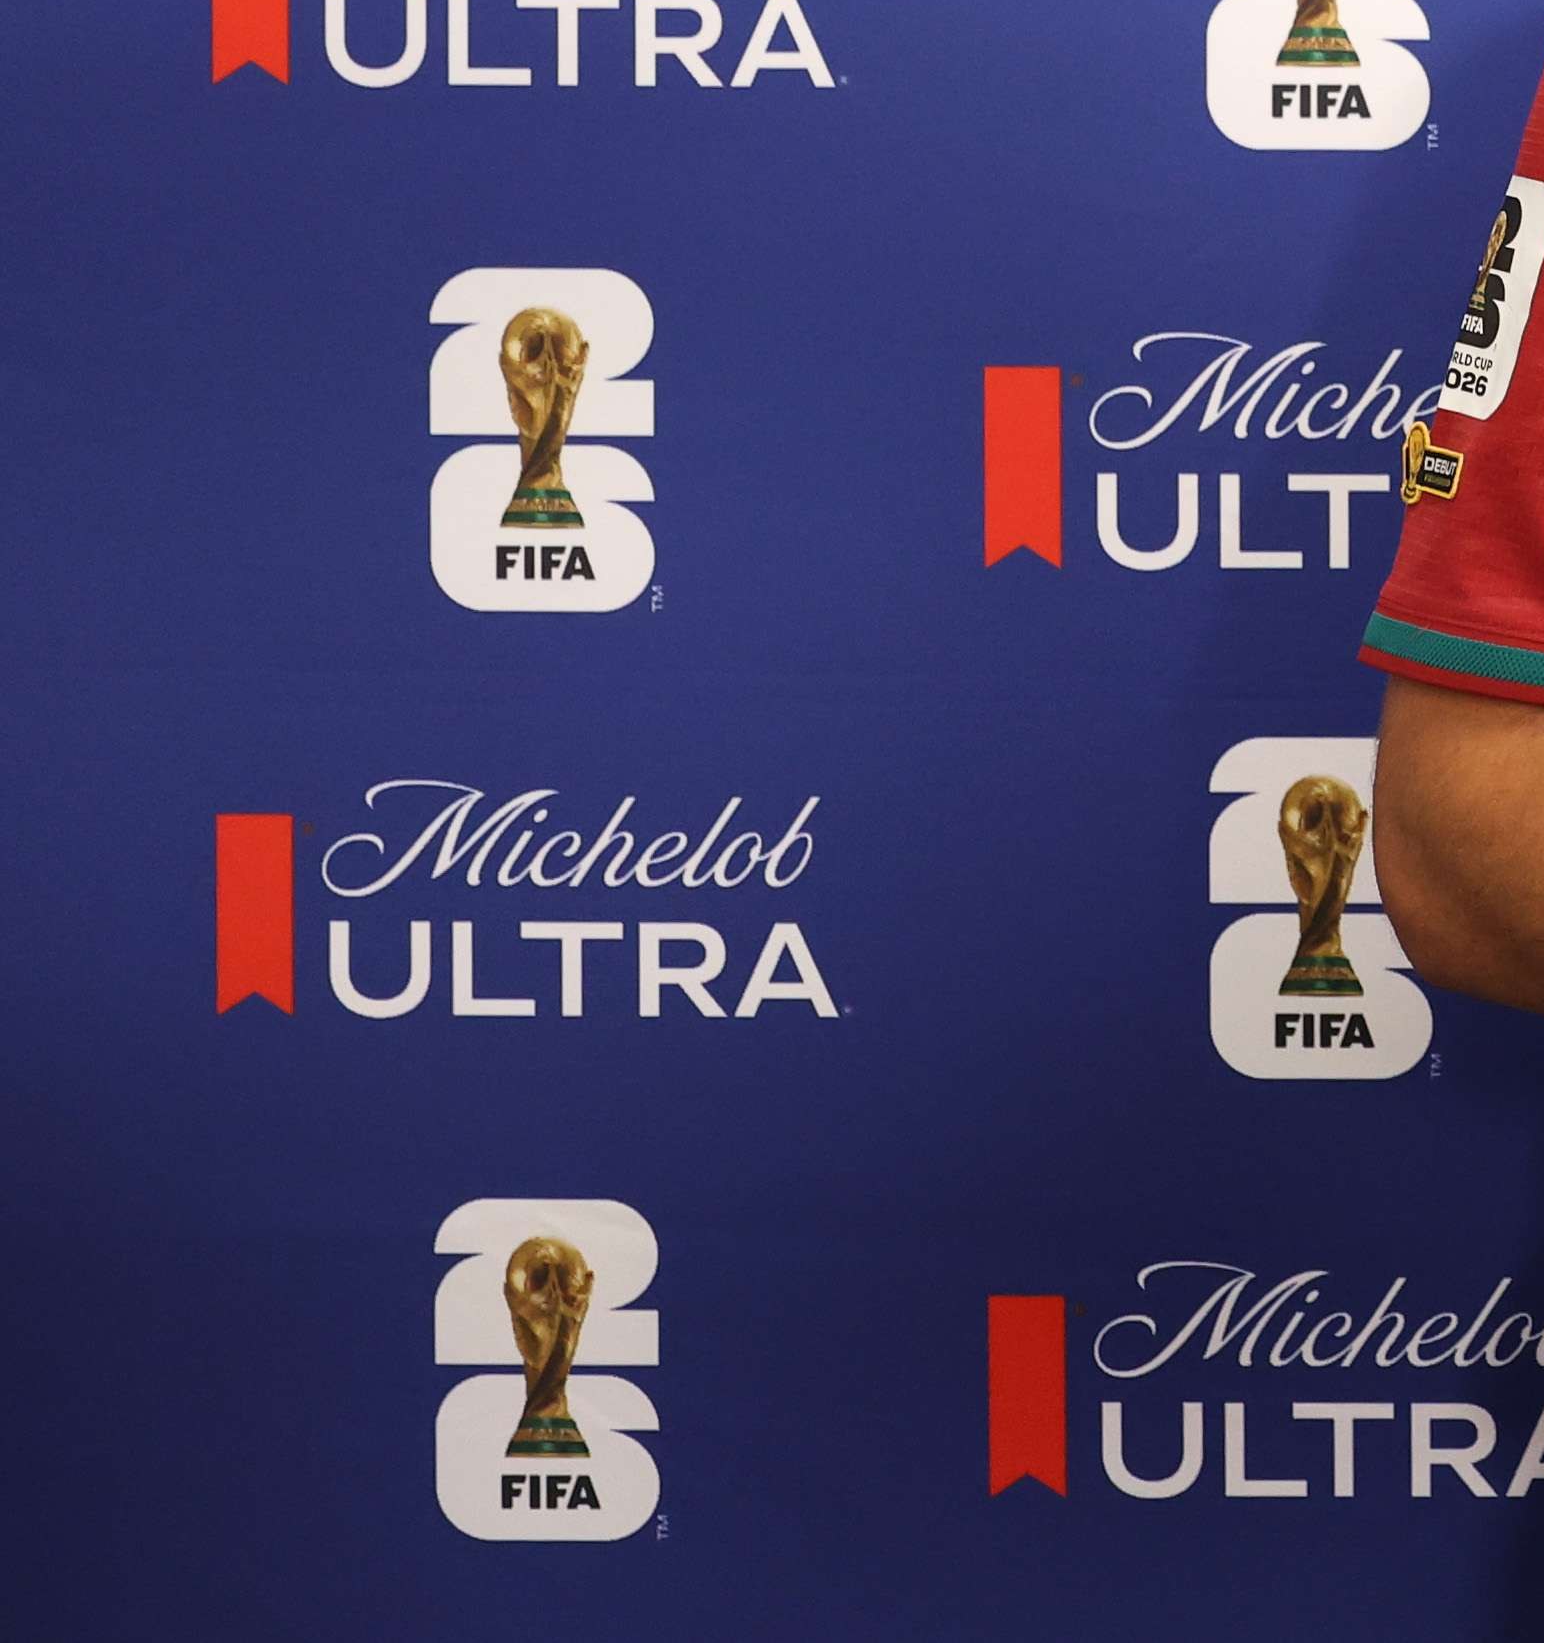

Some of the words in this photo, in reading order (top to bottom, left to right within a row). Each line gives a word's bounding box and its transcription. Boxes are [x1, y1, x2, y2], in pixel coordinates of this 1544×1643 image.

[1272, 85, 1370, 118] FIFA
[1460, 313, 1484, 335] FIFA
[1474, 356, 1493, 372] CUP
[1424, 456, 1457, 476] DEBUT
[1097, 473, 1391, 571] ULT
[496, 546, 594, 579] FIFA
[322, 780, 820, 896] Michelob
[330, 921, 838, 1018] ULTRA
[1275, 1014, 1374, 1048] FIFA
[502, 1475, 600, 1509] FIFA
